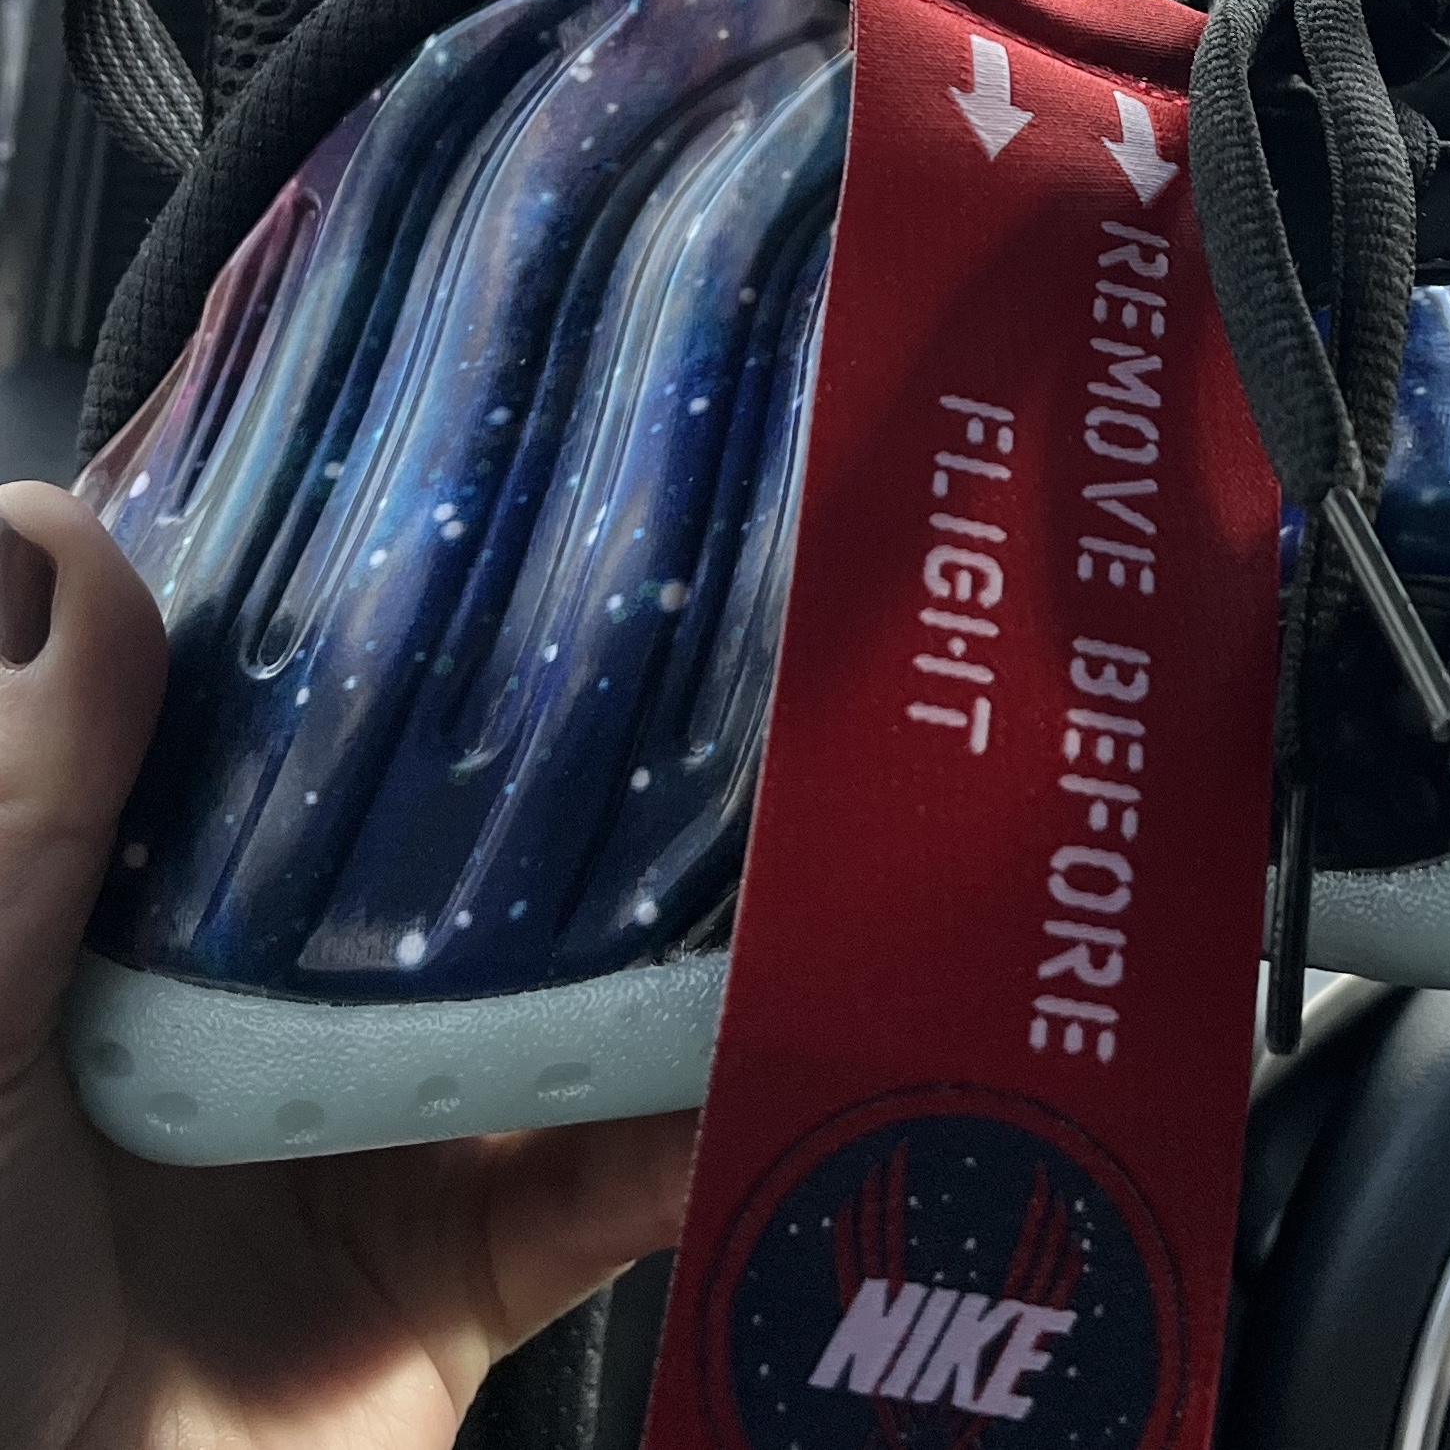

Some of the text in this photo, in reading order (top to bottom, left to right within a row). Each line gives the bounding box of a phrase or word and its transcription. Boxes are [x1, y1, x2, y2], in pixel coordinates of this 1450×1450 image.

[905, 394, 1016, 756] FLIGHT
[1028, 219, 1171, 1064] REMOVE BEFORE
[807, 1278, 1079, 1421] NIKE
